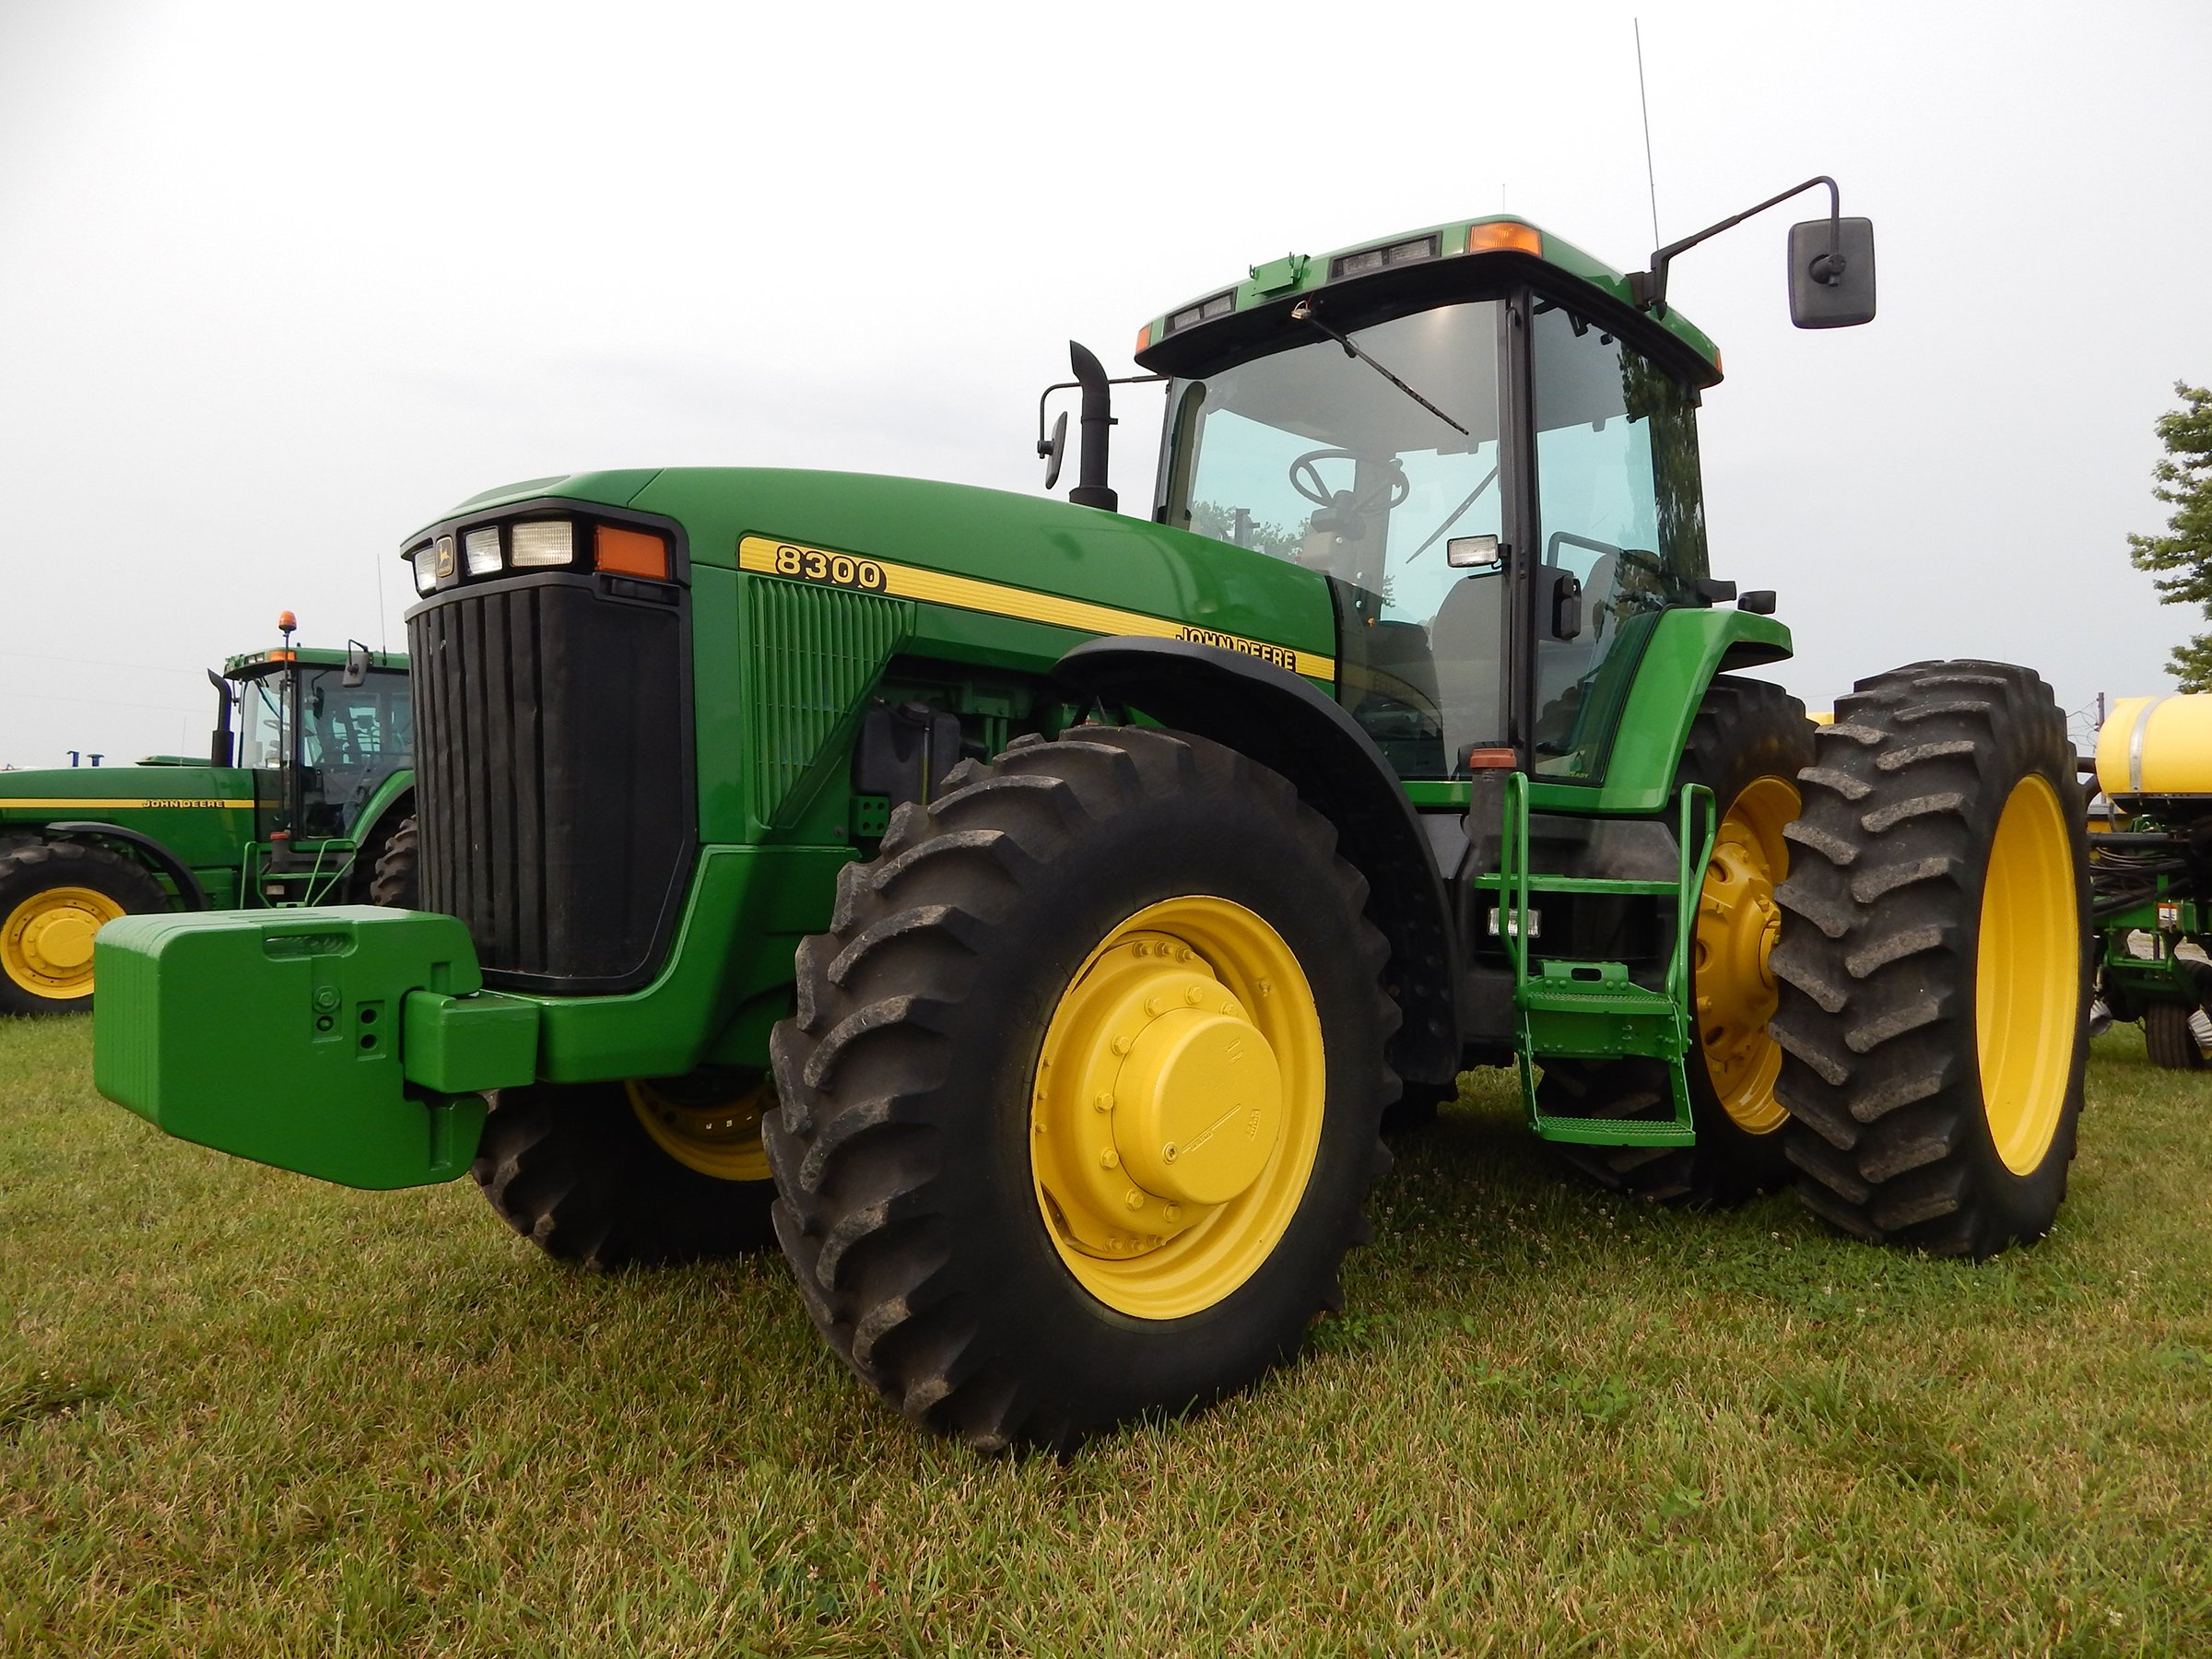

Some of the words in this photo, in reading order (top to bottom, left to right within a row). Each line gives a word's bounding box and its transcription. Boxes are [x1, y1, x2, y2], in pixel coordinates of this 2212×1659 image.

[776, 546, 886, 591] 8300
[1175, 627, 1233, 649] JOHN
[1237, 639, 1296, 673] DEERE
[143, 799, 181, 808] JOHN
[182, 799, 224, 808] DEERE
